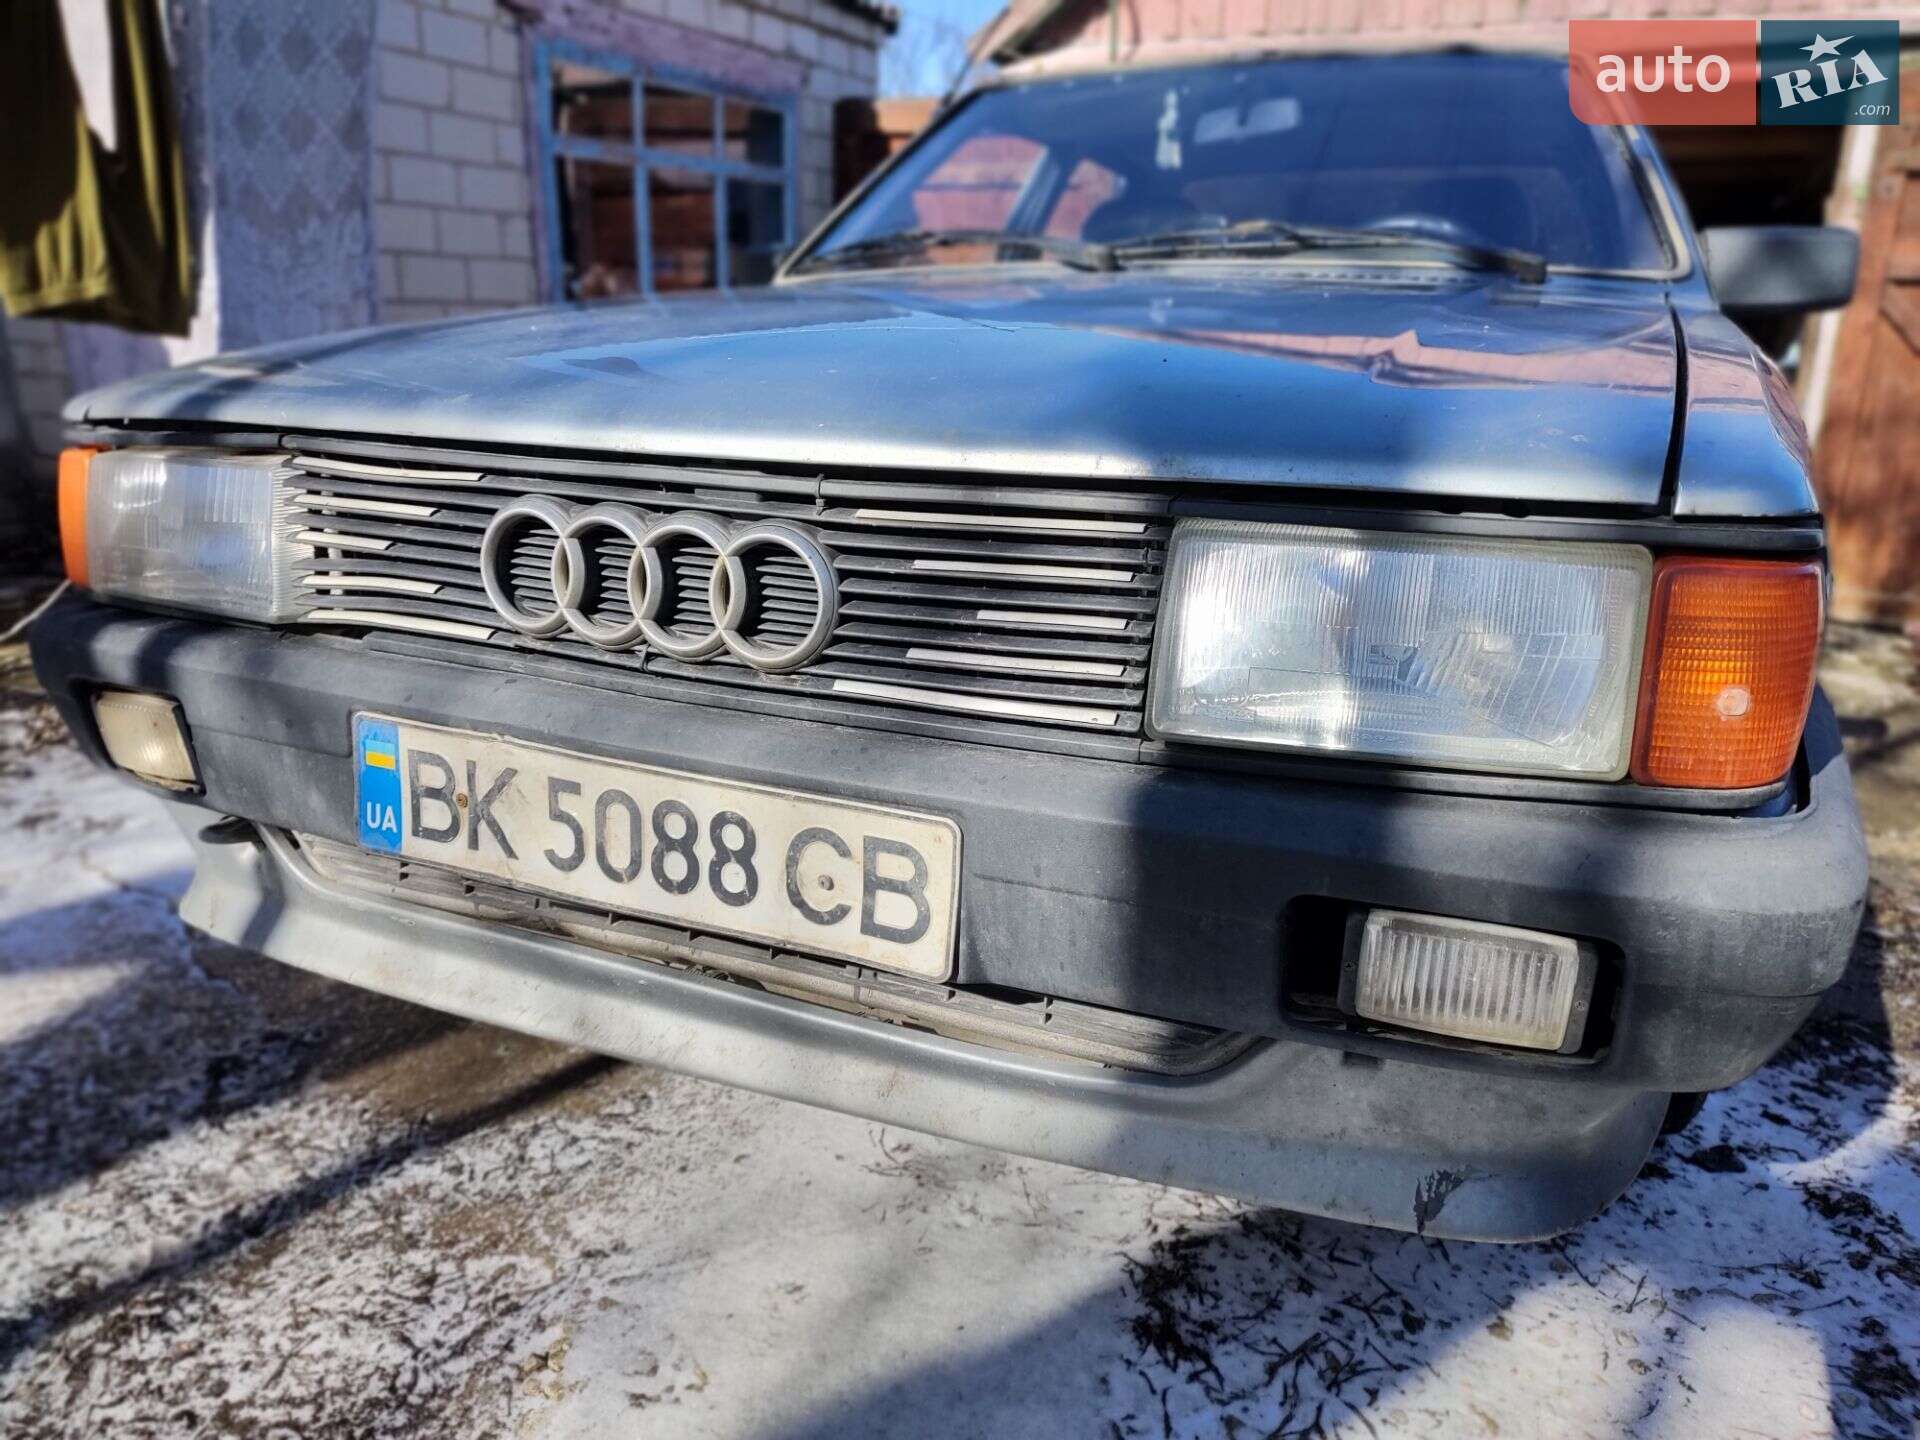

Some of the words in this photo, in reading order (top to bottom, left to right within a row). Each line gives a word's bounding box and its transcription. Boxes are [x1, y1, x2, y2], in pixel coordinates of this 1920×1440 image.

[367, 803, 397, 833] UA
[408, 750, 519, 859] BK
[544, 776, 759, 906] 5088
[786, 826, 931, 944] CB
